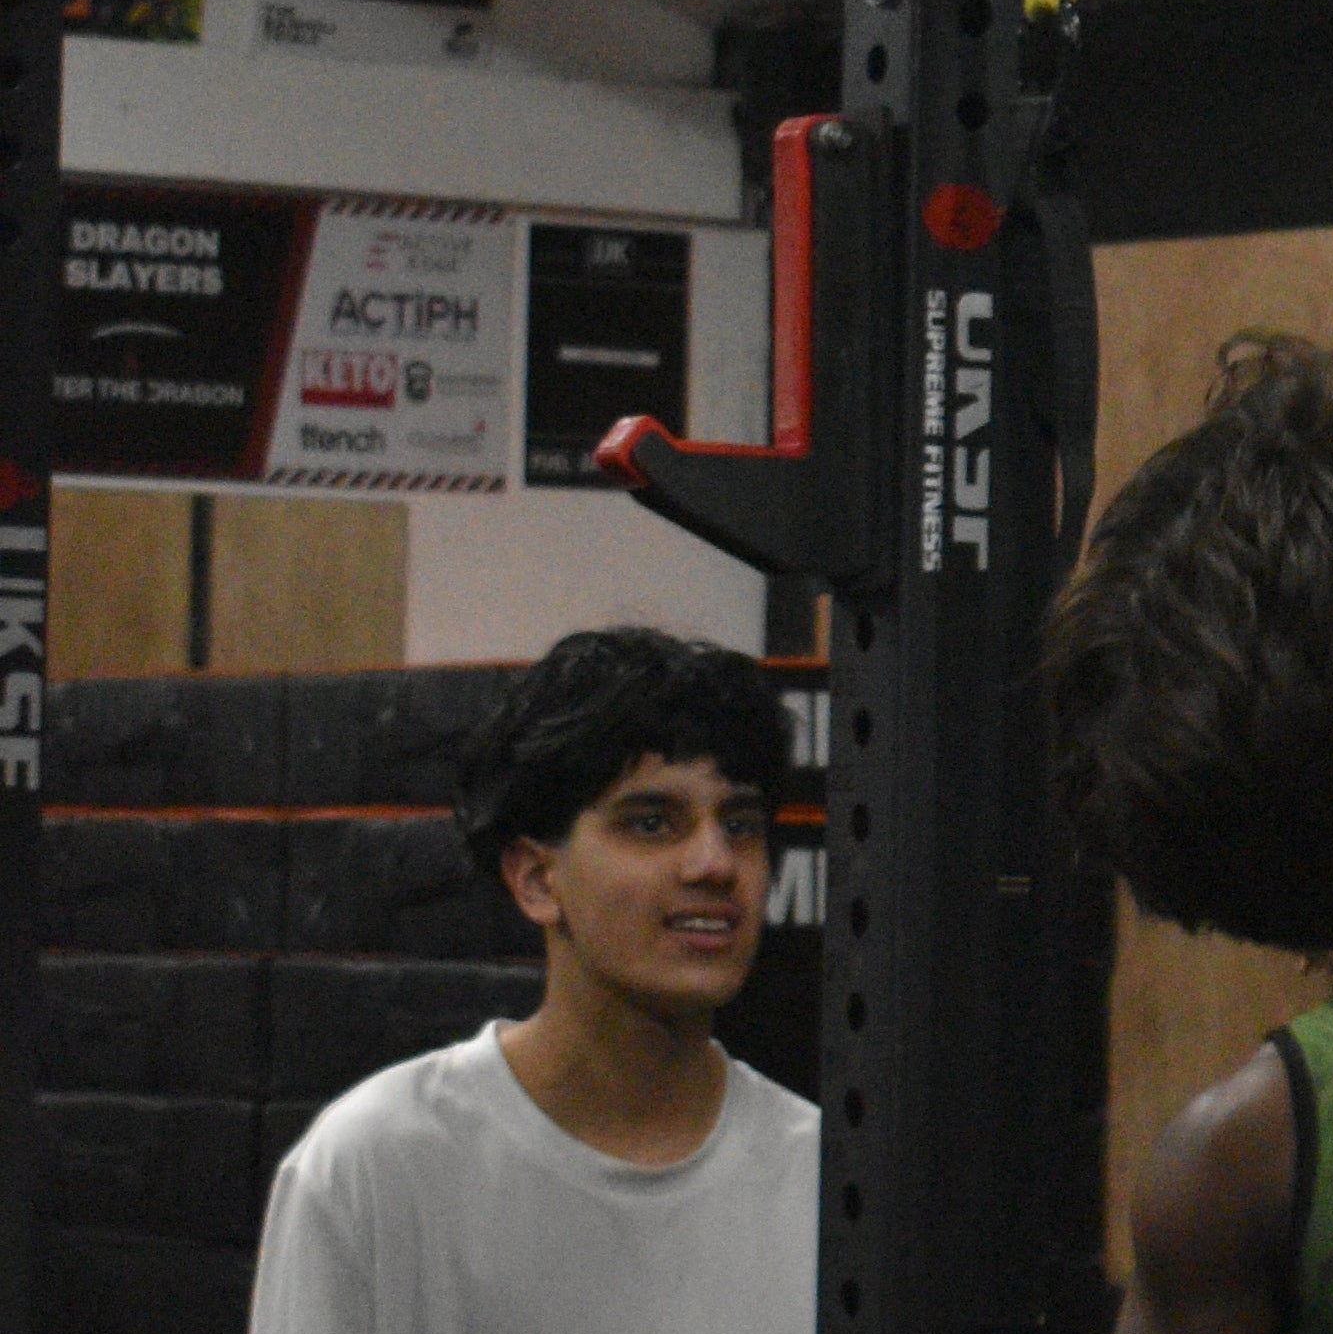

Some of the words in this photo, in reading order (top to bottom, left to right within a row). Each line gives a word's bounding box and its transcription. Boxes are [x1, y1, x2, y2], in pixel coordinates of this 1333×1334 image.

[64, 259, 224, 296] SLAYERS
[70, 219, 220, 258] DRAGON
[924, 290, 947, 437] SUPREME
[922, 444, 945, 571] FITNESS
